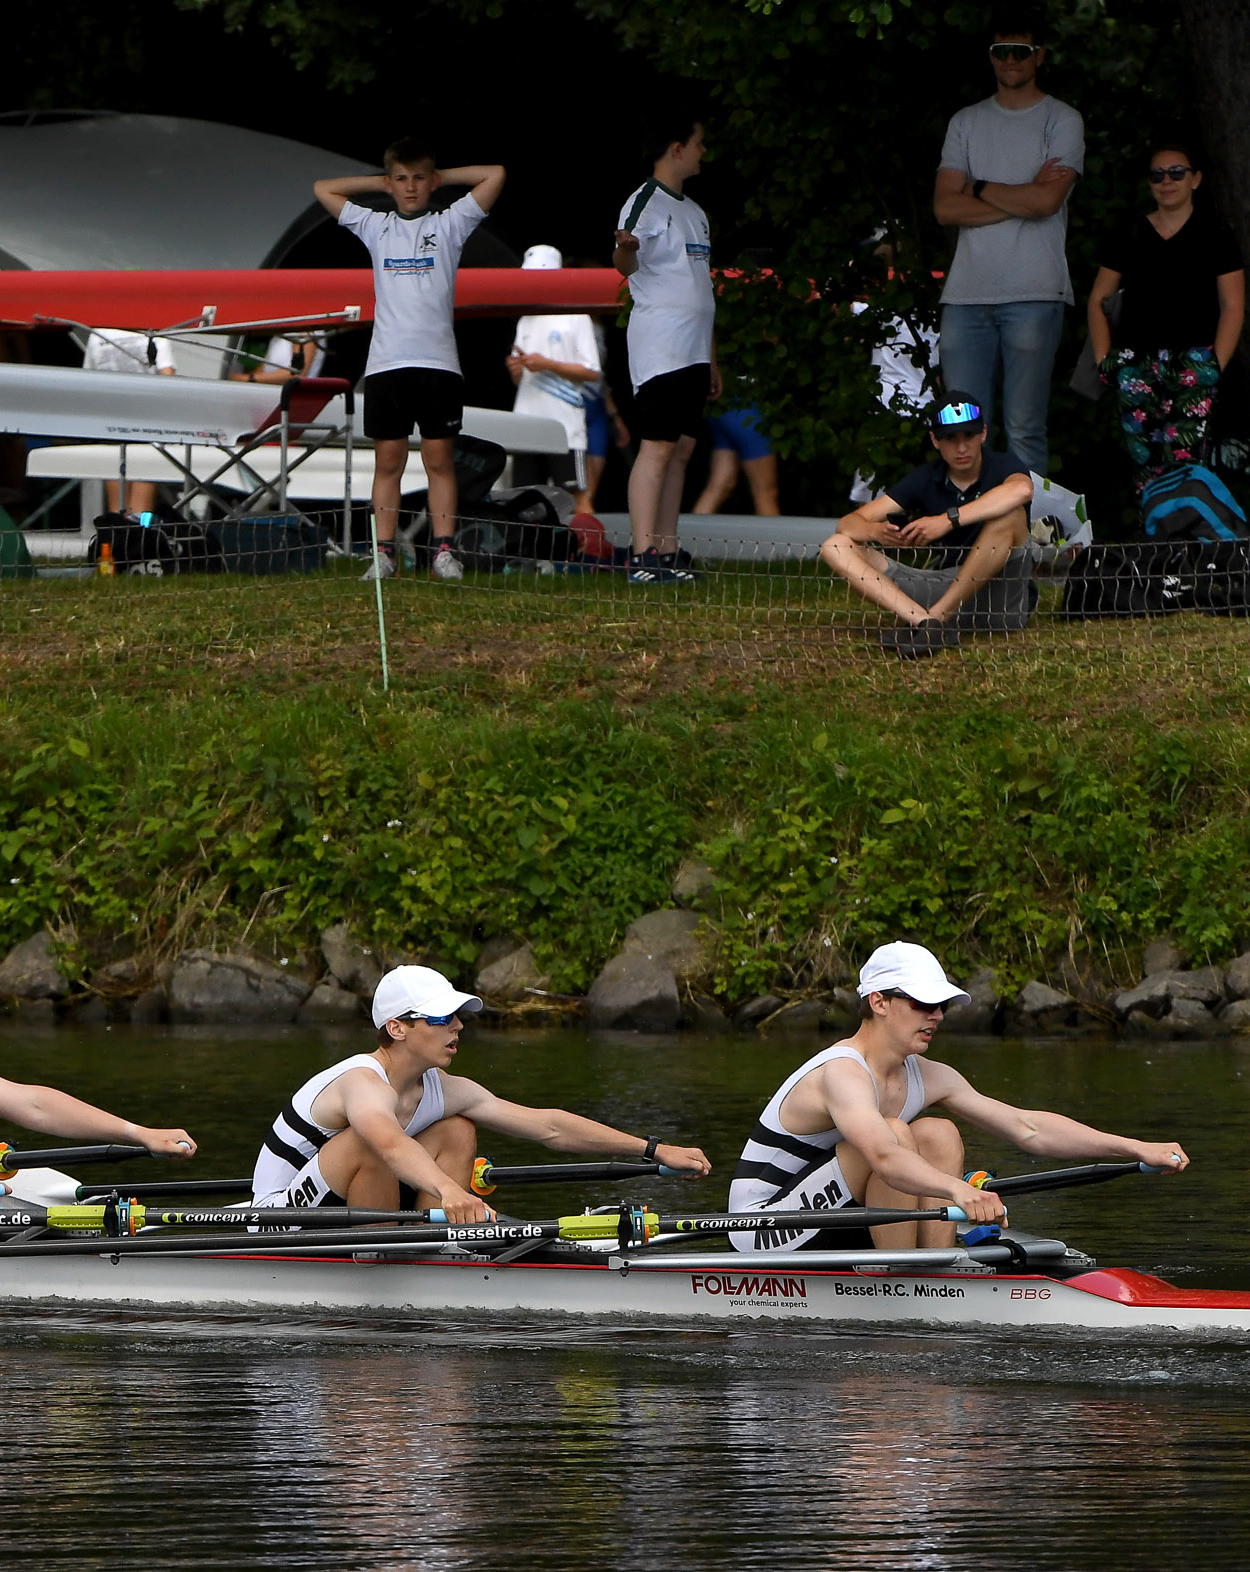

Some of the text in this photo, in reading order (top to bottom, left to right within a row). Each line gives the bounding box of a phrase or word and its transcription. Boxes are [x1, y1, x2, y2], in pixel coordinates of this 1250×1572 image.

[185, 1212, 260, 1223] concept 2
[700, 1217, 776, 1229] concept 2
[447, 1224, 542, 1240] besselrc.de
[692, 1275, 807, 1297] FOLLMANN
[834, 1283, 965, 1298] Bessel-R.C. Minden
[1010, 1288, 1052, 1300] BBG
[729, 1299, 808, 1309] your chemical experts
